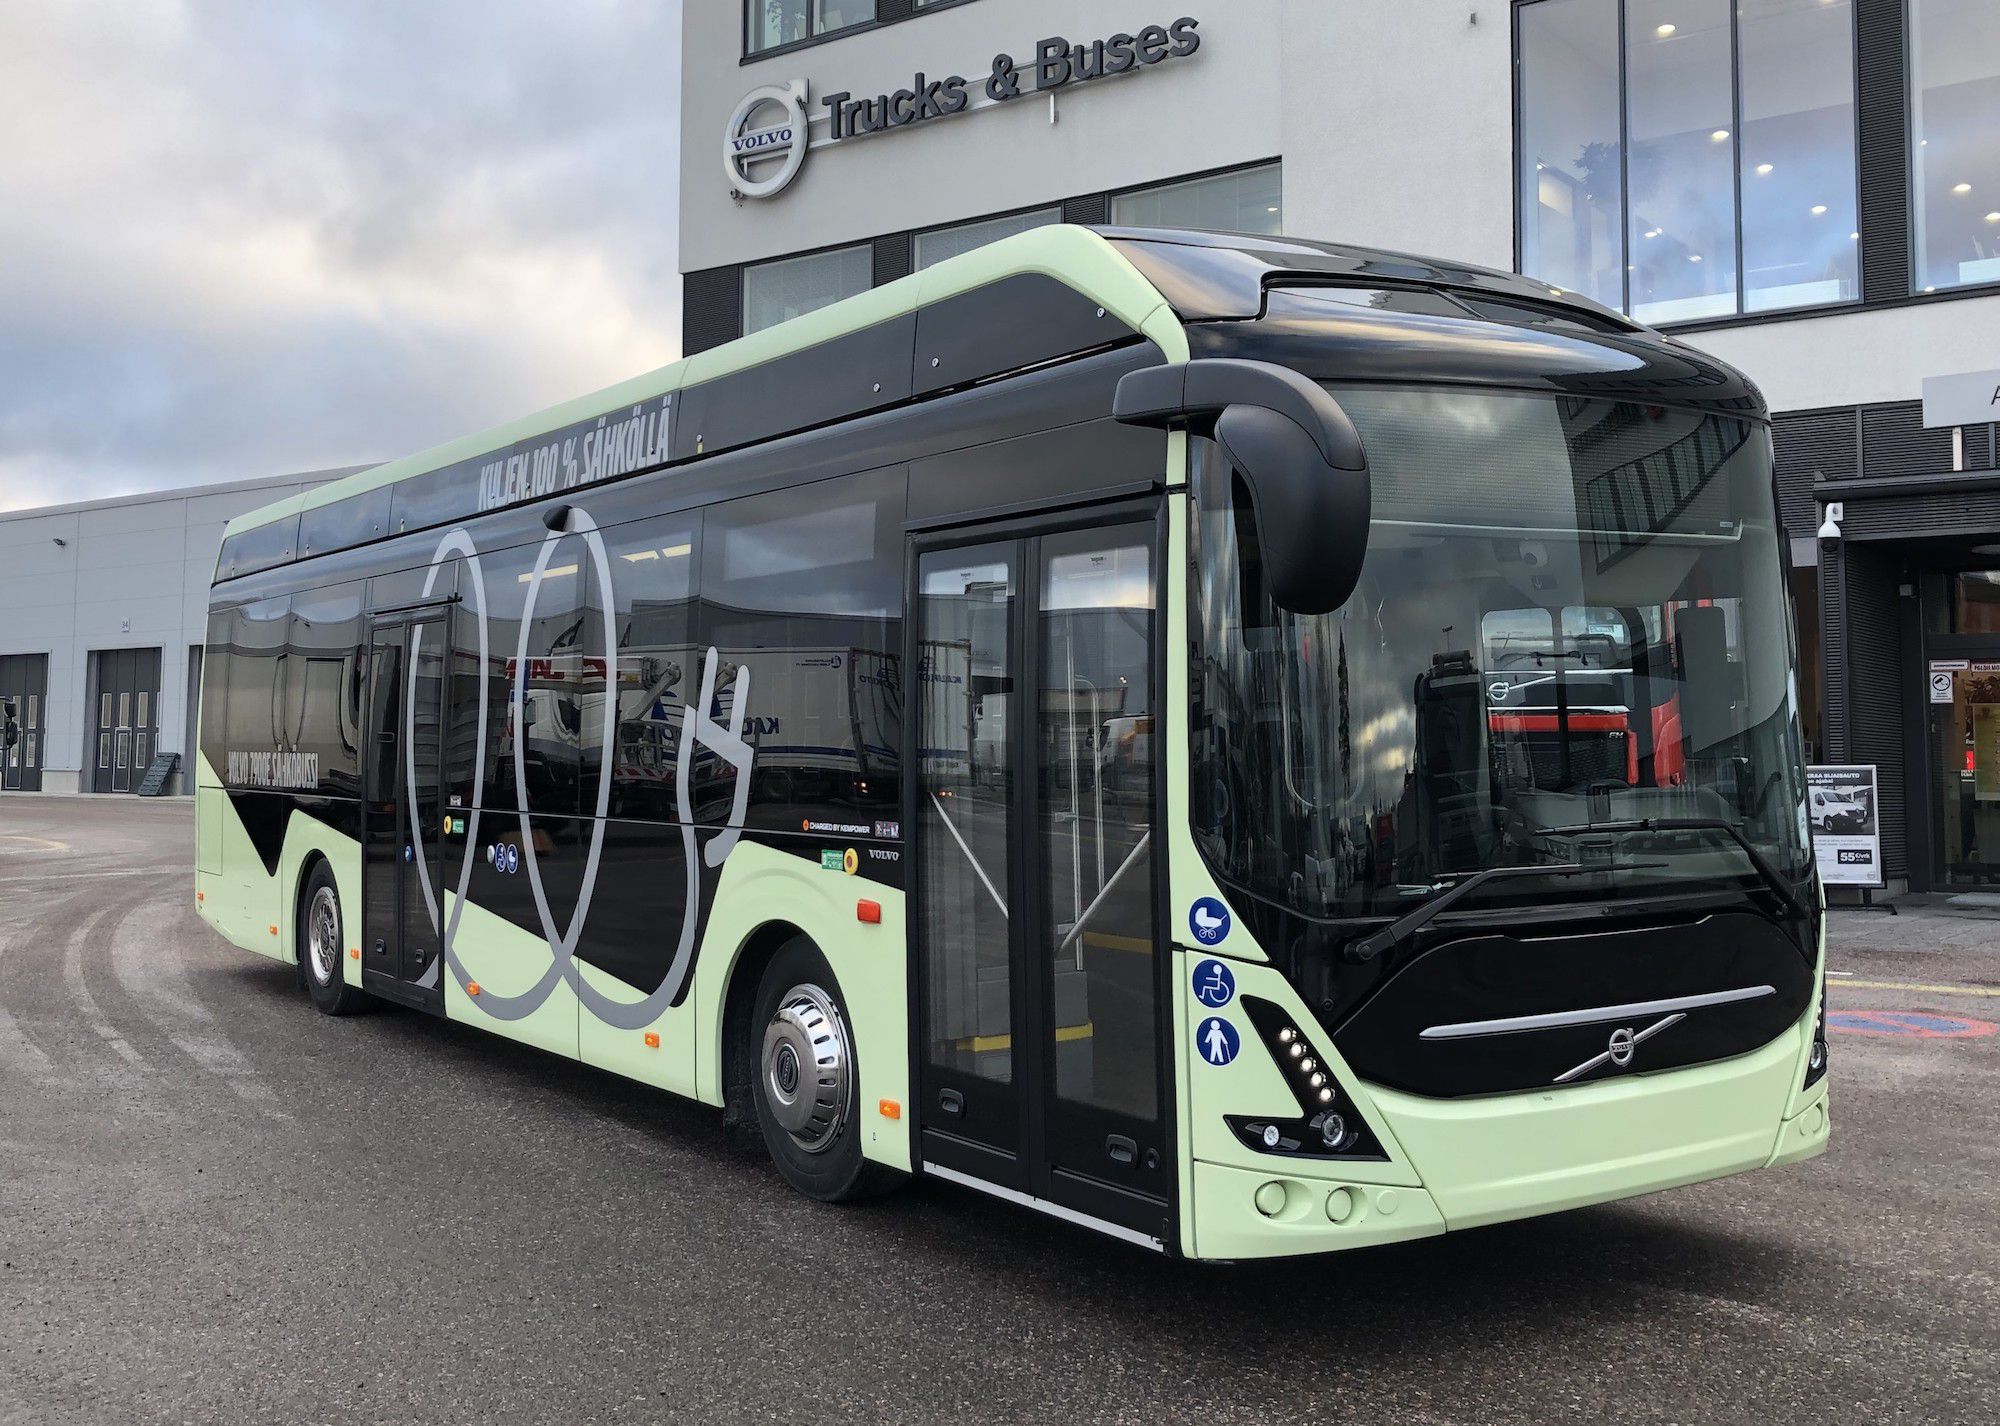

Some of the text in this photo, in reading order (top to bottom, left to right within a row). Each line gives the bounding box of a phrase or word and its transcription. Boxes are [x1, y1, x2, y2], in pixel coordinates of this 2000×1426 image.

[822, 16, 1201, 140] Trucks & Buses
[732, 128, 792, 151] VOLVO
[478, 394, 672, 512] KULJEN 100 % SÄHKÖLLÄ
[228, 744, 319, 789] VOLVO 7900E SÄHKÖBUSSI
[809, 822, 832, 831] CHARGED
[832, 824, 841, 832] BY
[840, 824, 870, 834] KEMPOWER
[868, 849, 899, 861] VOLVO
[1840, 852, 1855, 862] 55
